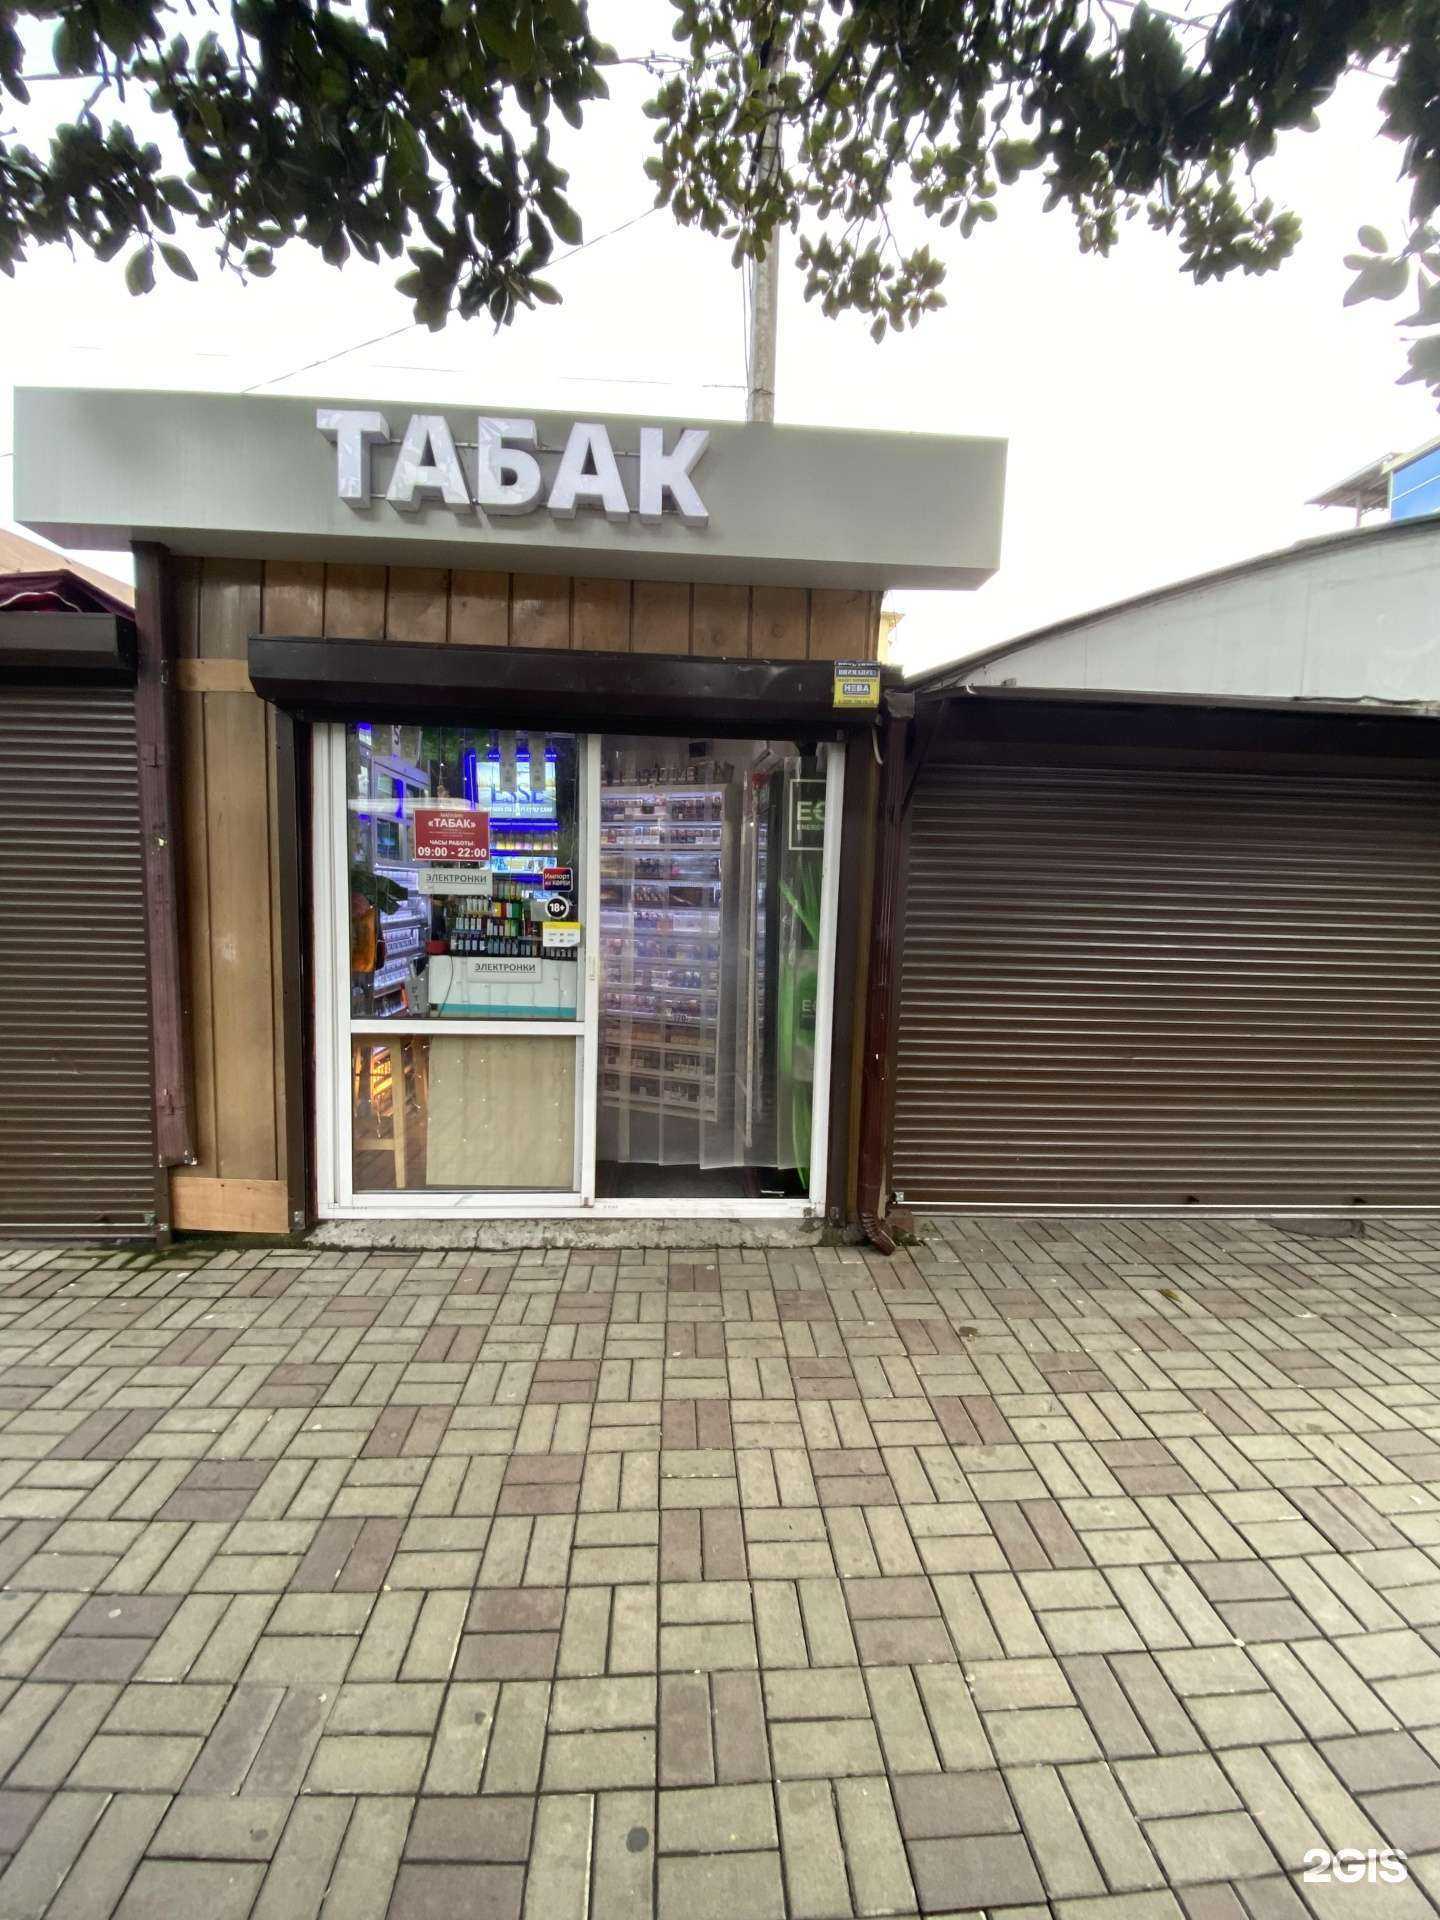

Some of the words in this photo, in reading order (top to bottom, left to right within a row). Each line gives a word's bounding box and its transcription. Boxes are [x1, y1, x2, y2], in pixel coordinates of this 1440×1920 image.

[316, 409, 710, 526] ТАБАК
[427, 818, 477, 828] «ТАБАК»
[417, 846, 448, 857] 09:00
[457, 847, 487, 858] 22:00
[425, 873, 487, 883] ЭЛЕКТРОНКИ
[544, 872, 570, 881] Импорт
[549, 902, 566, 913] 18+
[474, 962, 537, 972] ЭЛЕКТРОНКИ
